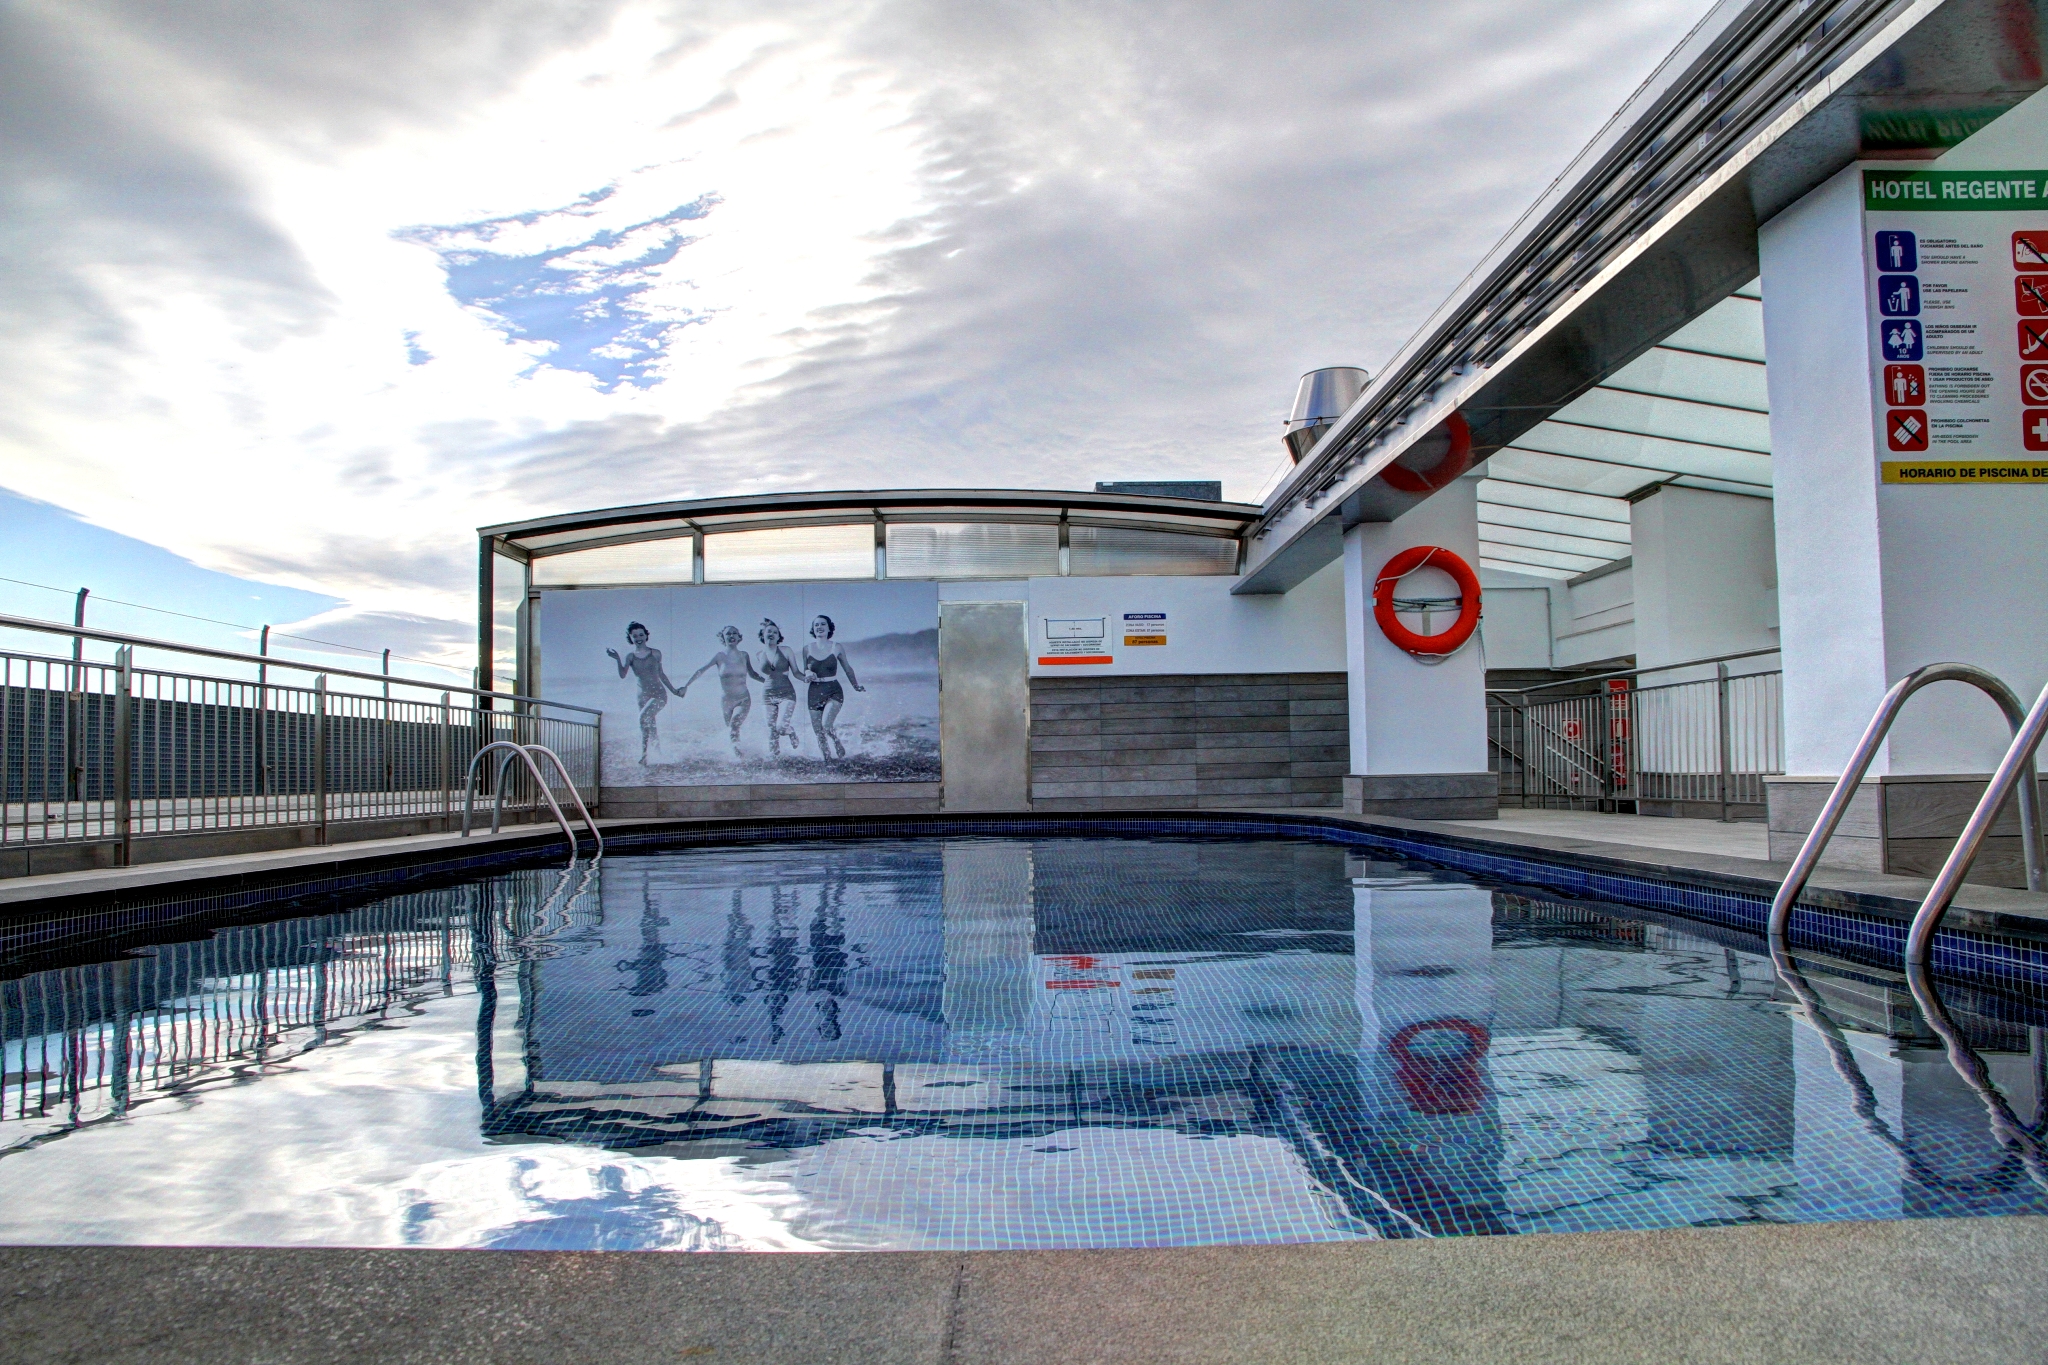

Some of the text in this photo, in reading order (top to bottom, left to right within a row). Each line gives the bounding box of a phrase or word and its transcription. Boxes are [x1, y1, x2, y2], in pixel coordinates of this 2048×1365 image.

[1872, 181, 1937, 198] HOTEL
[1942, 180, 2036, 198] REGENTE
[1900, 469, 1956, 478] HORARIO
[1960, 468, 1976, 477] DE
[1980, 468, 2028, 477] PISCINA
